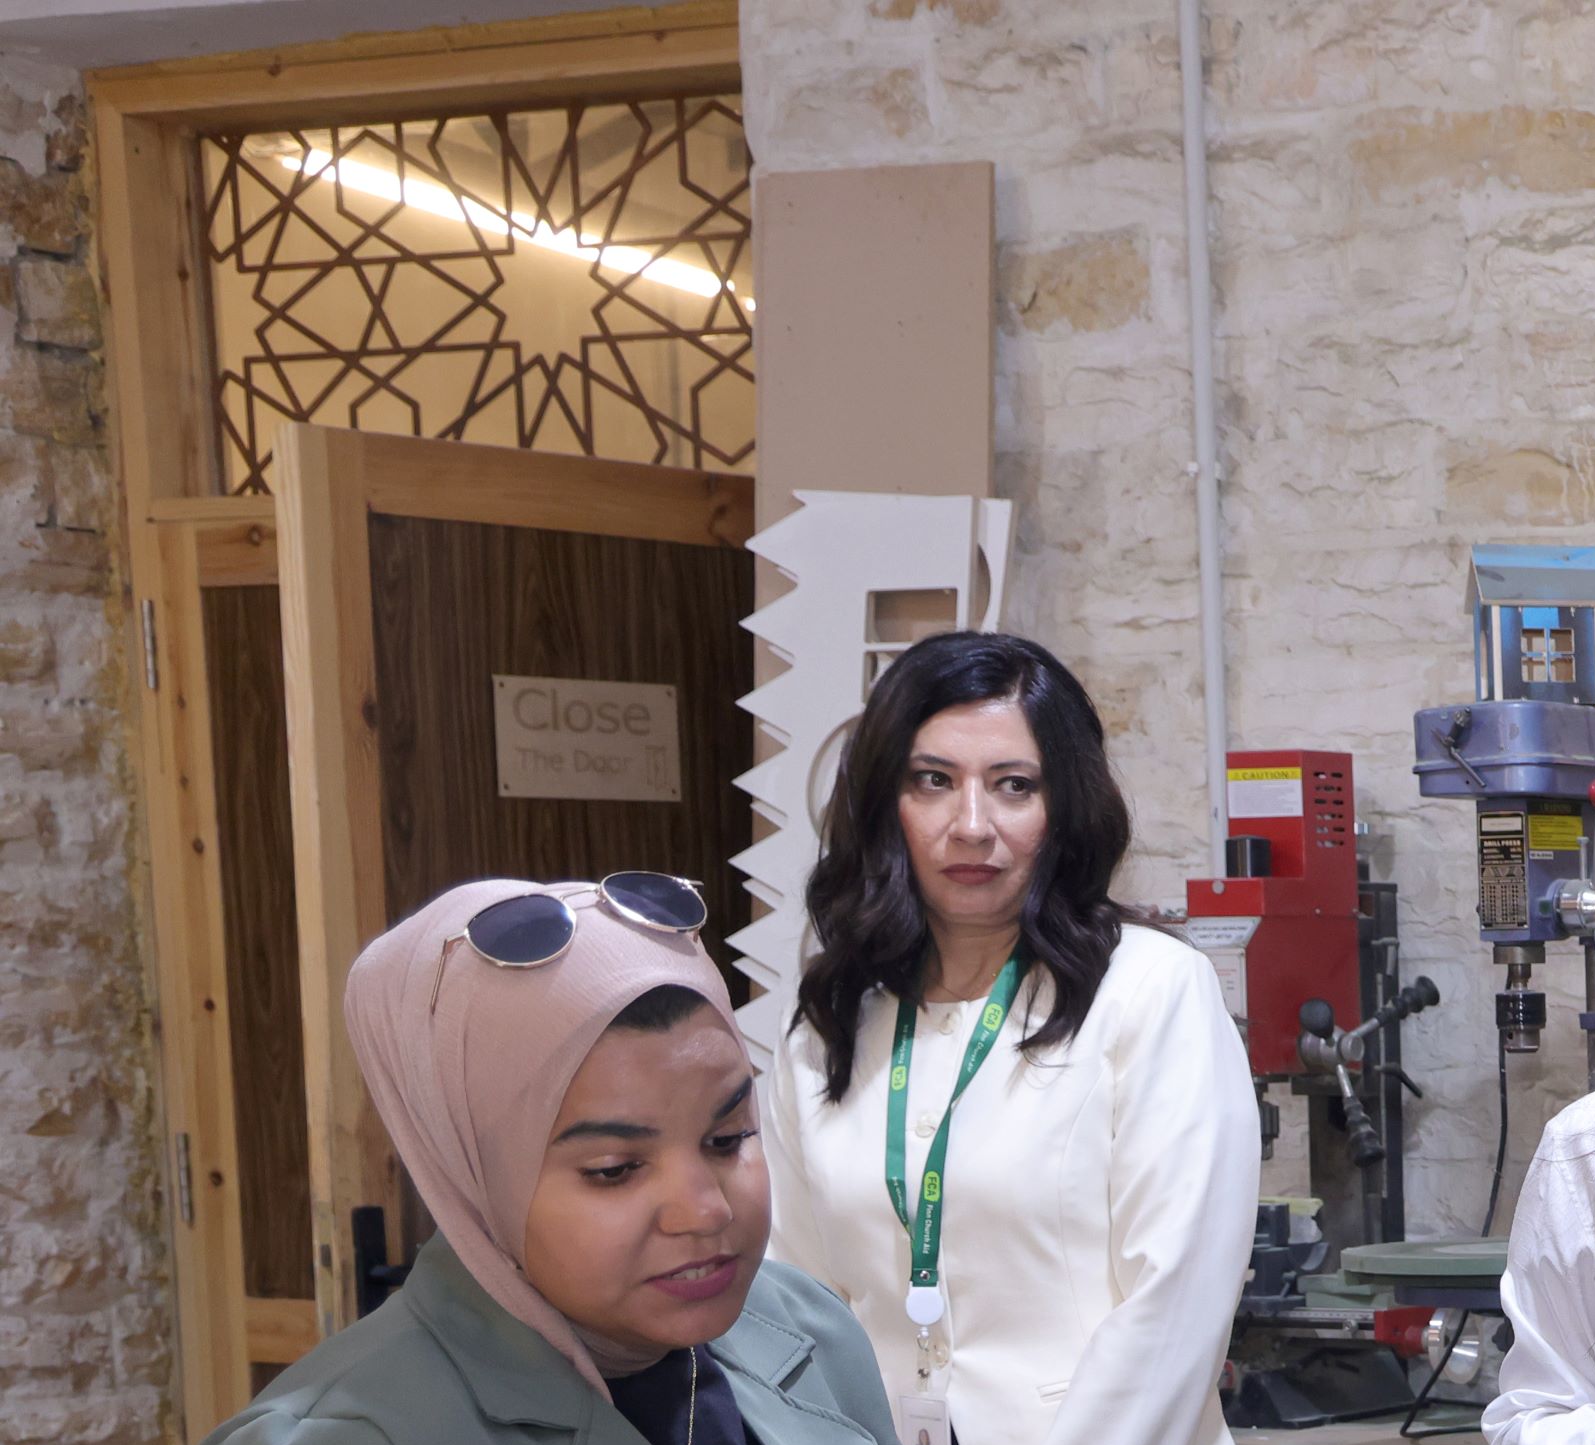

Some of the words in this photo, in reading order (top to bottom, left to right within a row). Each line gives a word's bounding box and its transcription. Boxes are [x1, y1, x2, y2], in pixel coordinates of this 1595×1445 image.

[512, 688, 651, 736] Close
[514, 746, 564, 773] The
[573, 749, 633, 775] Door
[1241, 770, 1289, 780] CAUTION
[985, 1007, 1000, 1026] FCA
[927, 1176, 937, 1197] FCA
[923, 1219, 932, 1243] Church
[922, 1243, 930, 1255] Aid
